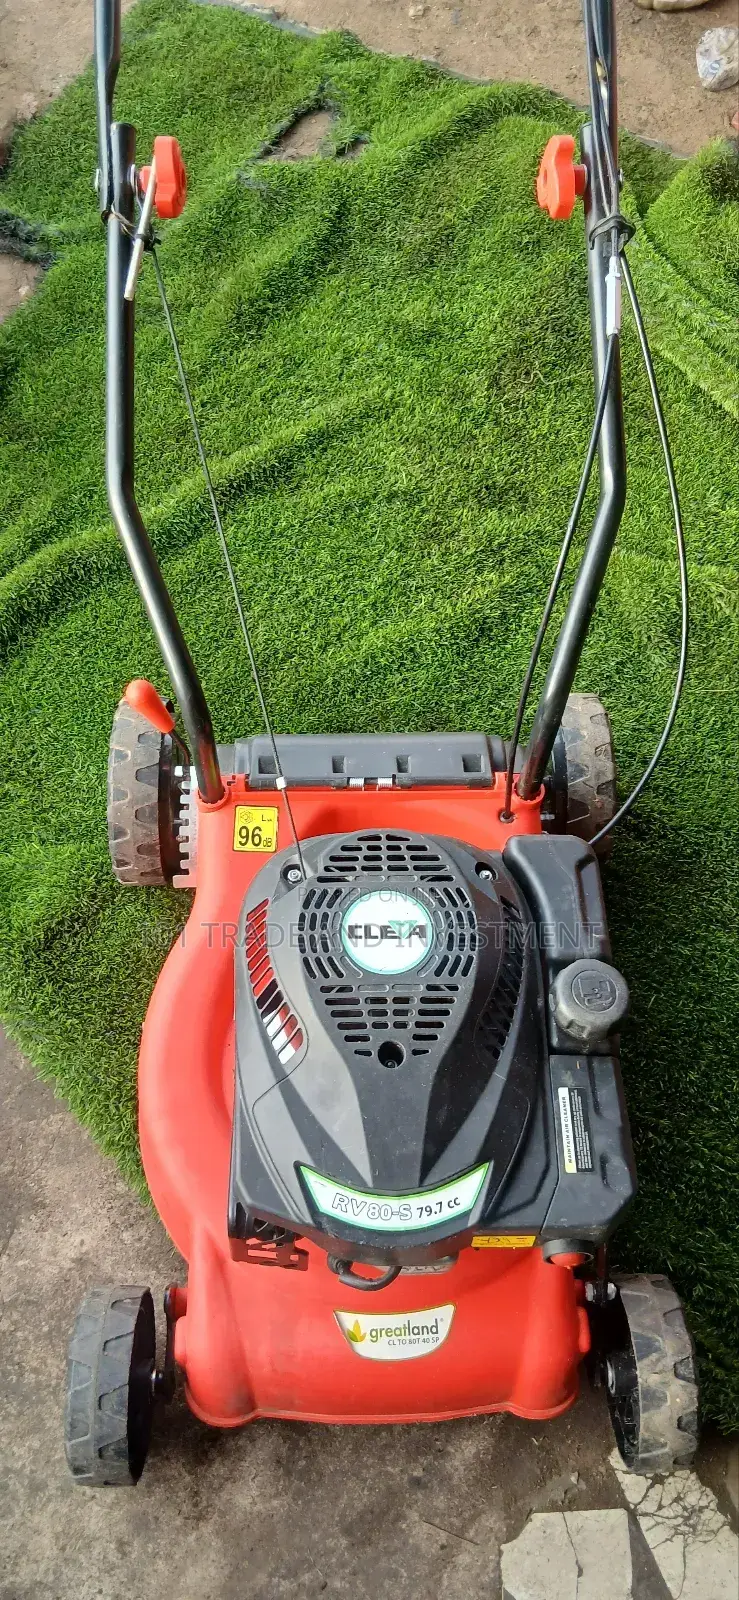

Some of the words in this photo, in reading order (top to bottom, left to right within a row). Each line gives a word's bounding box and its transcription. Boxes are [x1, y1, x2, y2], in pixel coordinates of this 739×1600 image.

[238, 825, 263, 847] 96
[262, 837, 273, 848] dB
[332, 1193, 412, 1221] RV80-S
[416, 1201, 443, 1219] 79.7
[369, 1318, 439, 1343] greatland
[431, 1336, 440, 1344] SP
